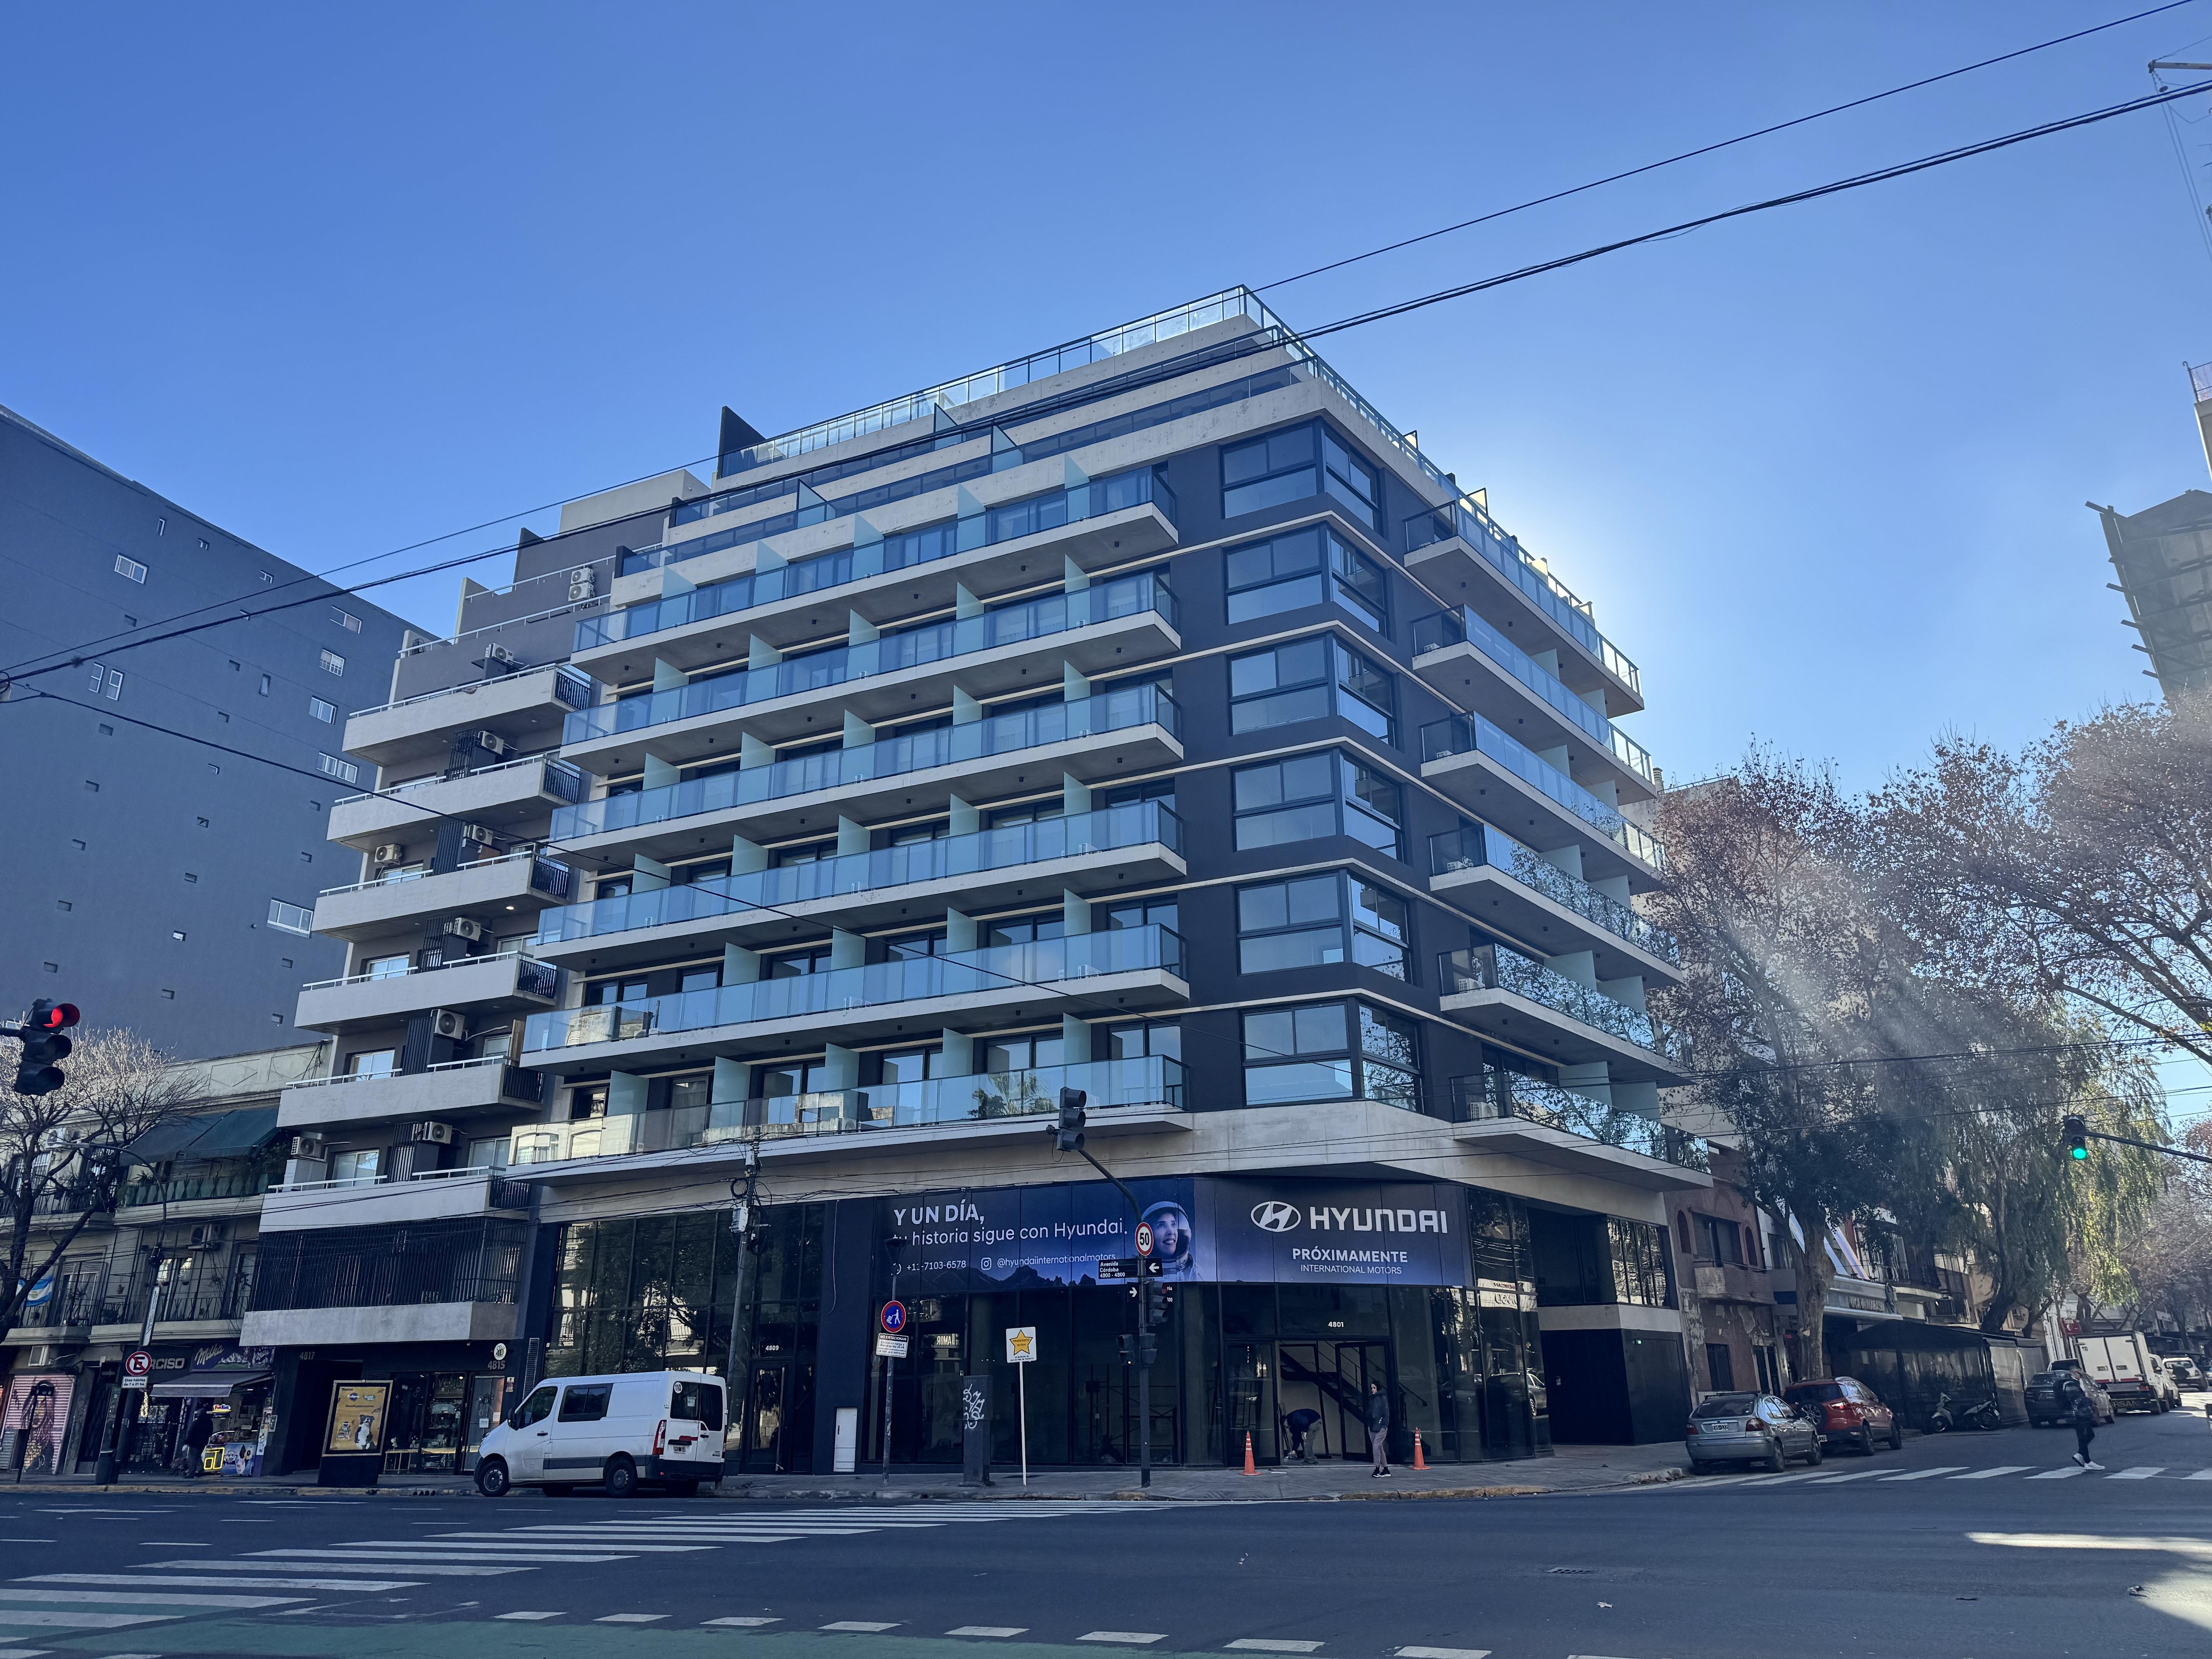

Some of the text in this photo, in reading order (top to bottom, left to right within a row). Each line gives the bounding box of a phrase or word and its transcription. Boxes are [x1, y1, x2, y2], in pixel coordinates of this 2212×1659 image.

[893, 1199, 984, 1226] Y UN DÍA,
[1310, 1207, 1448, 1233] HYUNDAI
[913, 1218, 1127, 1245] historia sigue con Hyundai.
[1140, 1233, 1149, 1245] 50
[998, 1254, 1116, 1267] @hyundaiinternationalmotors
[1293, 1245, 1408, 1262] PRÓXIMAMENTE
[1301, 1264, 1402, 1274] INTERNATIONAL MOTORS
[194, 1343, 224, 1365] Milka
[299, 1351, 315, 1360] 4817
[488, 1360, 506, 1370] 4815
